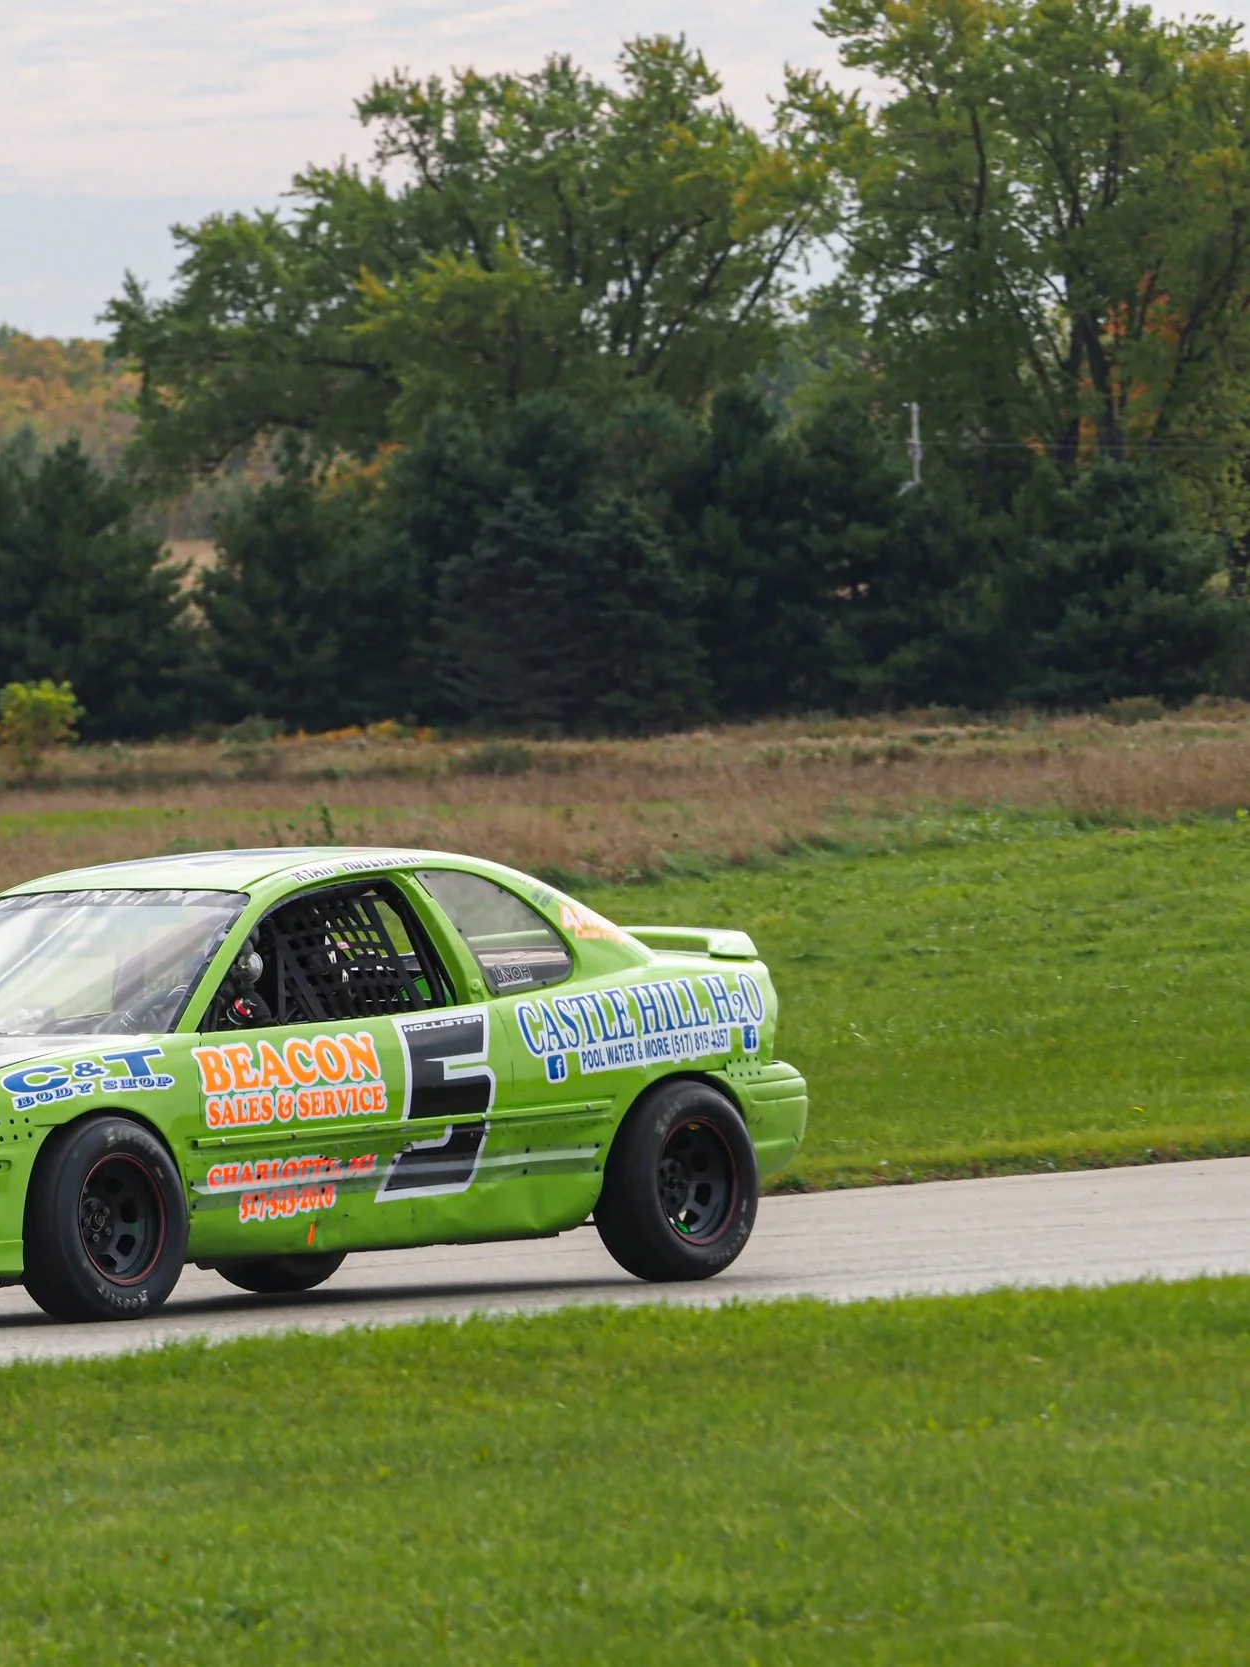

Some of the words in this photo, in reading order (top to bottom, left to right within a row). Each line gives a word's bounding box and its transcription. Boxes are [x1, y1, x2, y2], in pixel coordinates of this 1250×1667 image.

[403, 1015, 482, 1032] HOLLISTER
[518, 984, 635, 1053] CASTLE
[630, 979, 710, 1035] HILL
[3, 1049, 162, 1093] C&T
[194, 1035, 381, 1093] BEACON
[581, 1048, 605, 1070] POOL
[605, 1043, 636, 1066] WATER
[637, 1043, 644, 1060] &
[644, 1036, 671, 1058] MORE
[671, 1032, 694, 1058] (517)
[15, 1083, 92, 1109] BODY
[103, 1075, 173, 1089] SHOP
[208, 1095, 272, 1127] SALES
[276, 1093, 293, 1121] &
[297, 1084, 385, 1118] SERVICE
[377, 1007, 495, 1201] 5
